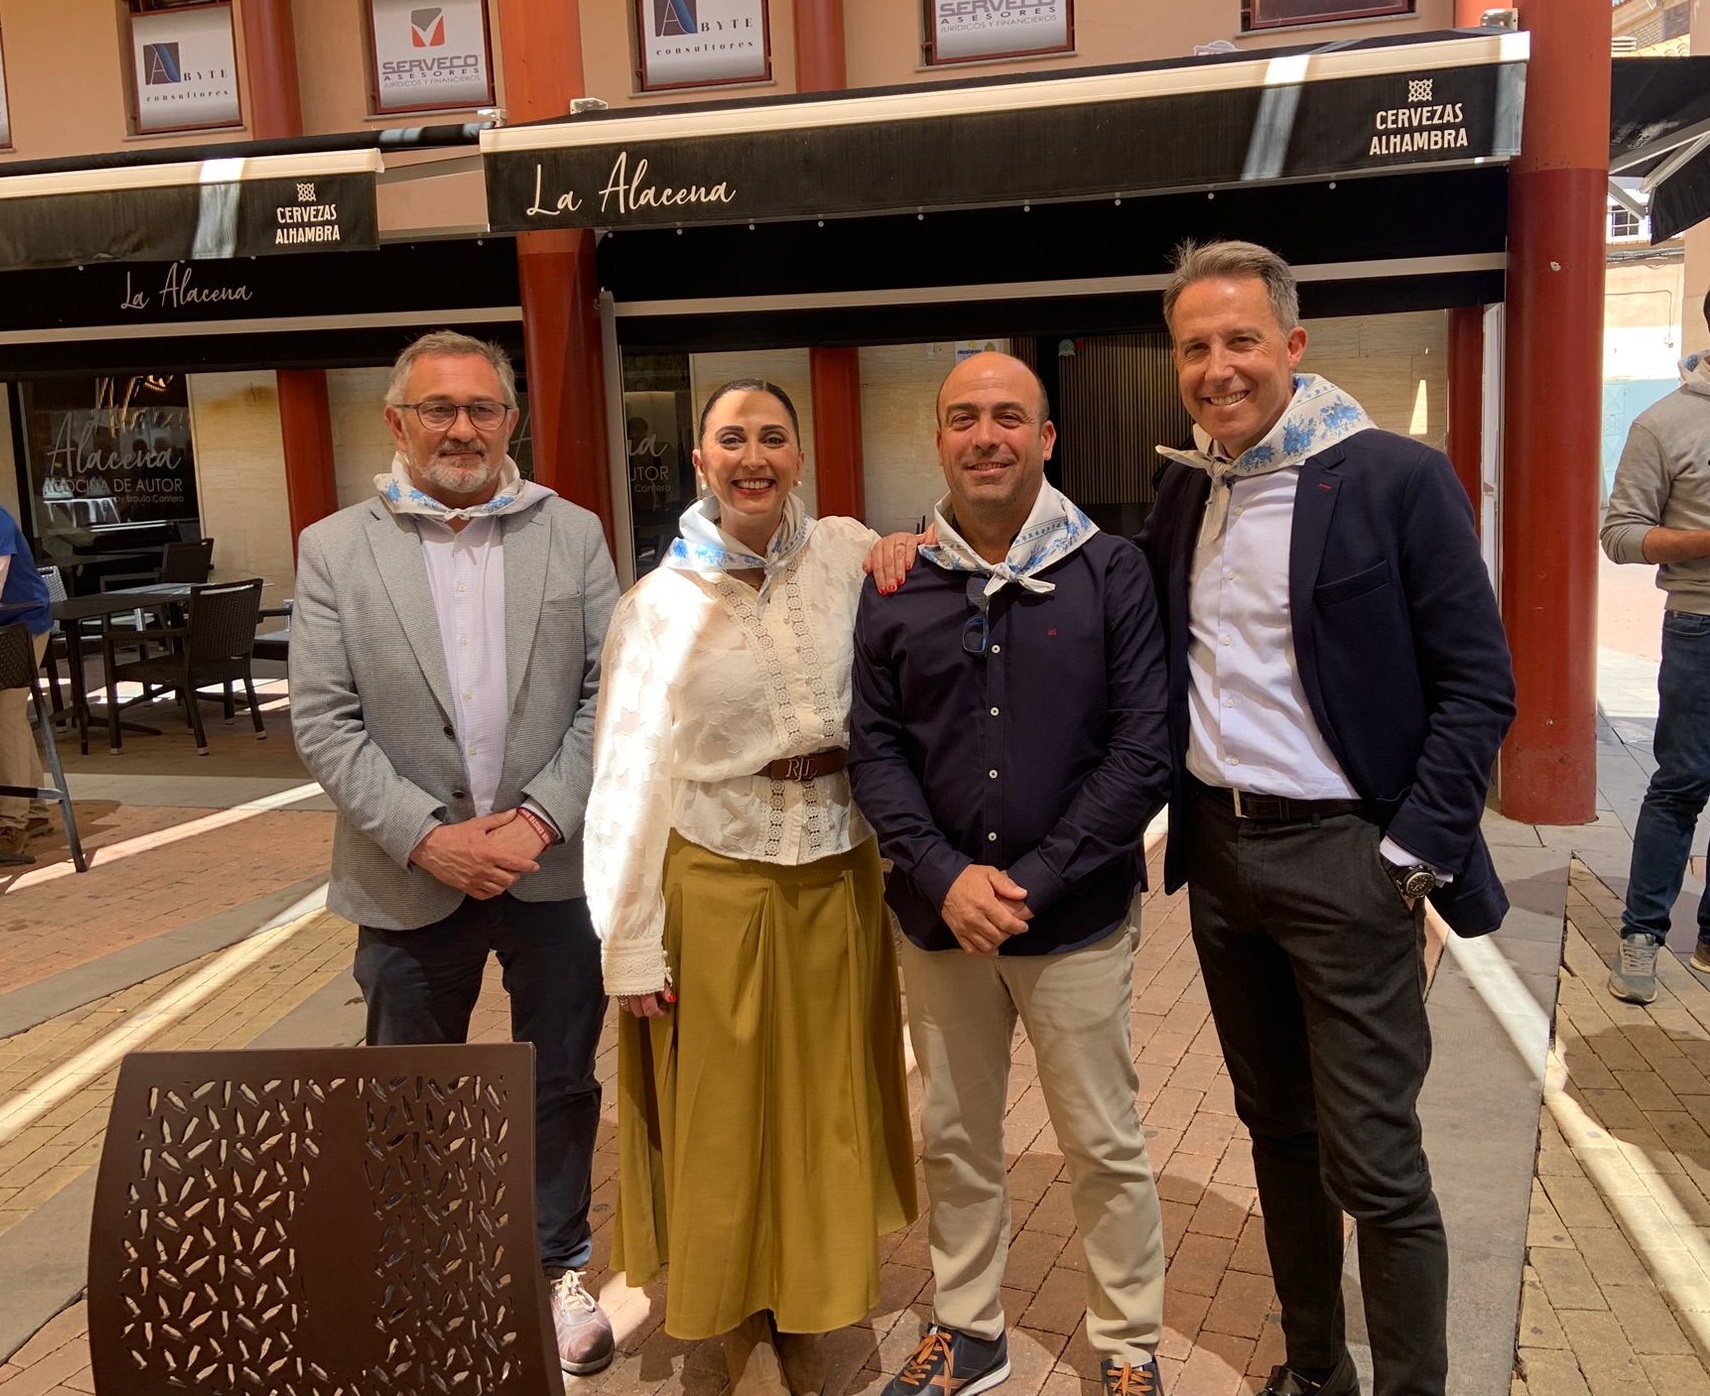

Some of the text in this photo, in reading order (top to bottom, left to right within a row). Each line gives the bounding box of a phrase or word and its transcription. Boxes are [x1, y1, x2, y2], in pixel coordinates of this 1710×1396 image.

[941, 6, 1056, 25] ASESORES
[989, 20, 994, 28] Y
[996, 14, 1057, 27] FINANCIEROS
[656, 41, 754, 56] consultores
[382, 54, 479, 75] SERVECO
[384, 67, 480, 82] ASESORES
[146, 90, 228, 102] consultores
[1376, 102, 1464, 130] CERVEZAS
[1369, 127, 1469, 156] ALHAMBRA
[526, 151, 737, 216] La Alacena
[276, 203, 337, 224] CERVEZAS
[275, 224, 341, 245] ALHAMBRA
[120, 262, 253, 310] La Alacena
[47, 411, 182, 477] Alacena
[630, 465, 669, 481] UTOR
[113, 477, 131, 493] DE
[136, 477, 183, 493] AUTOR
